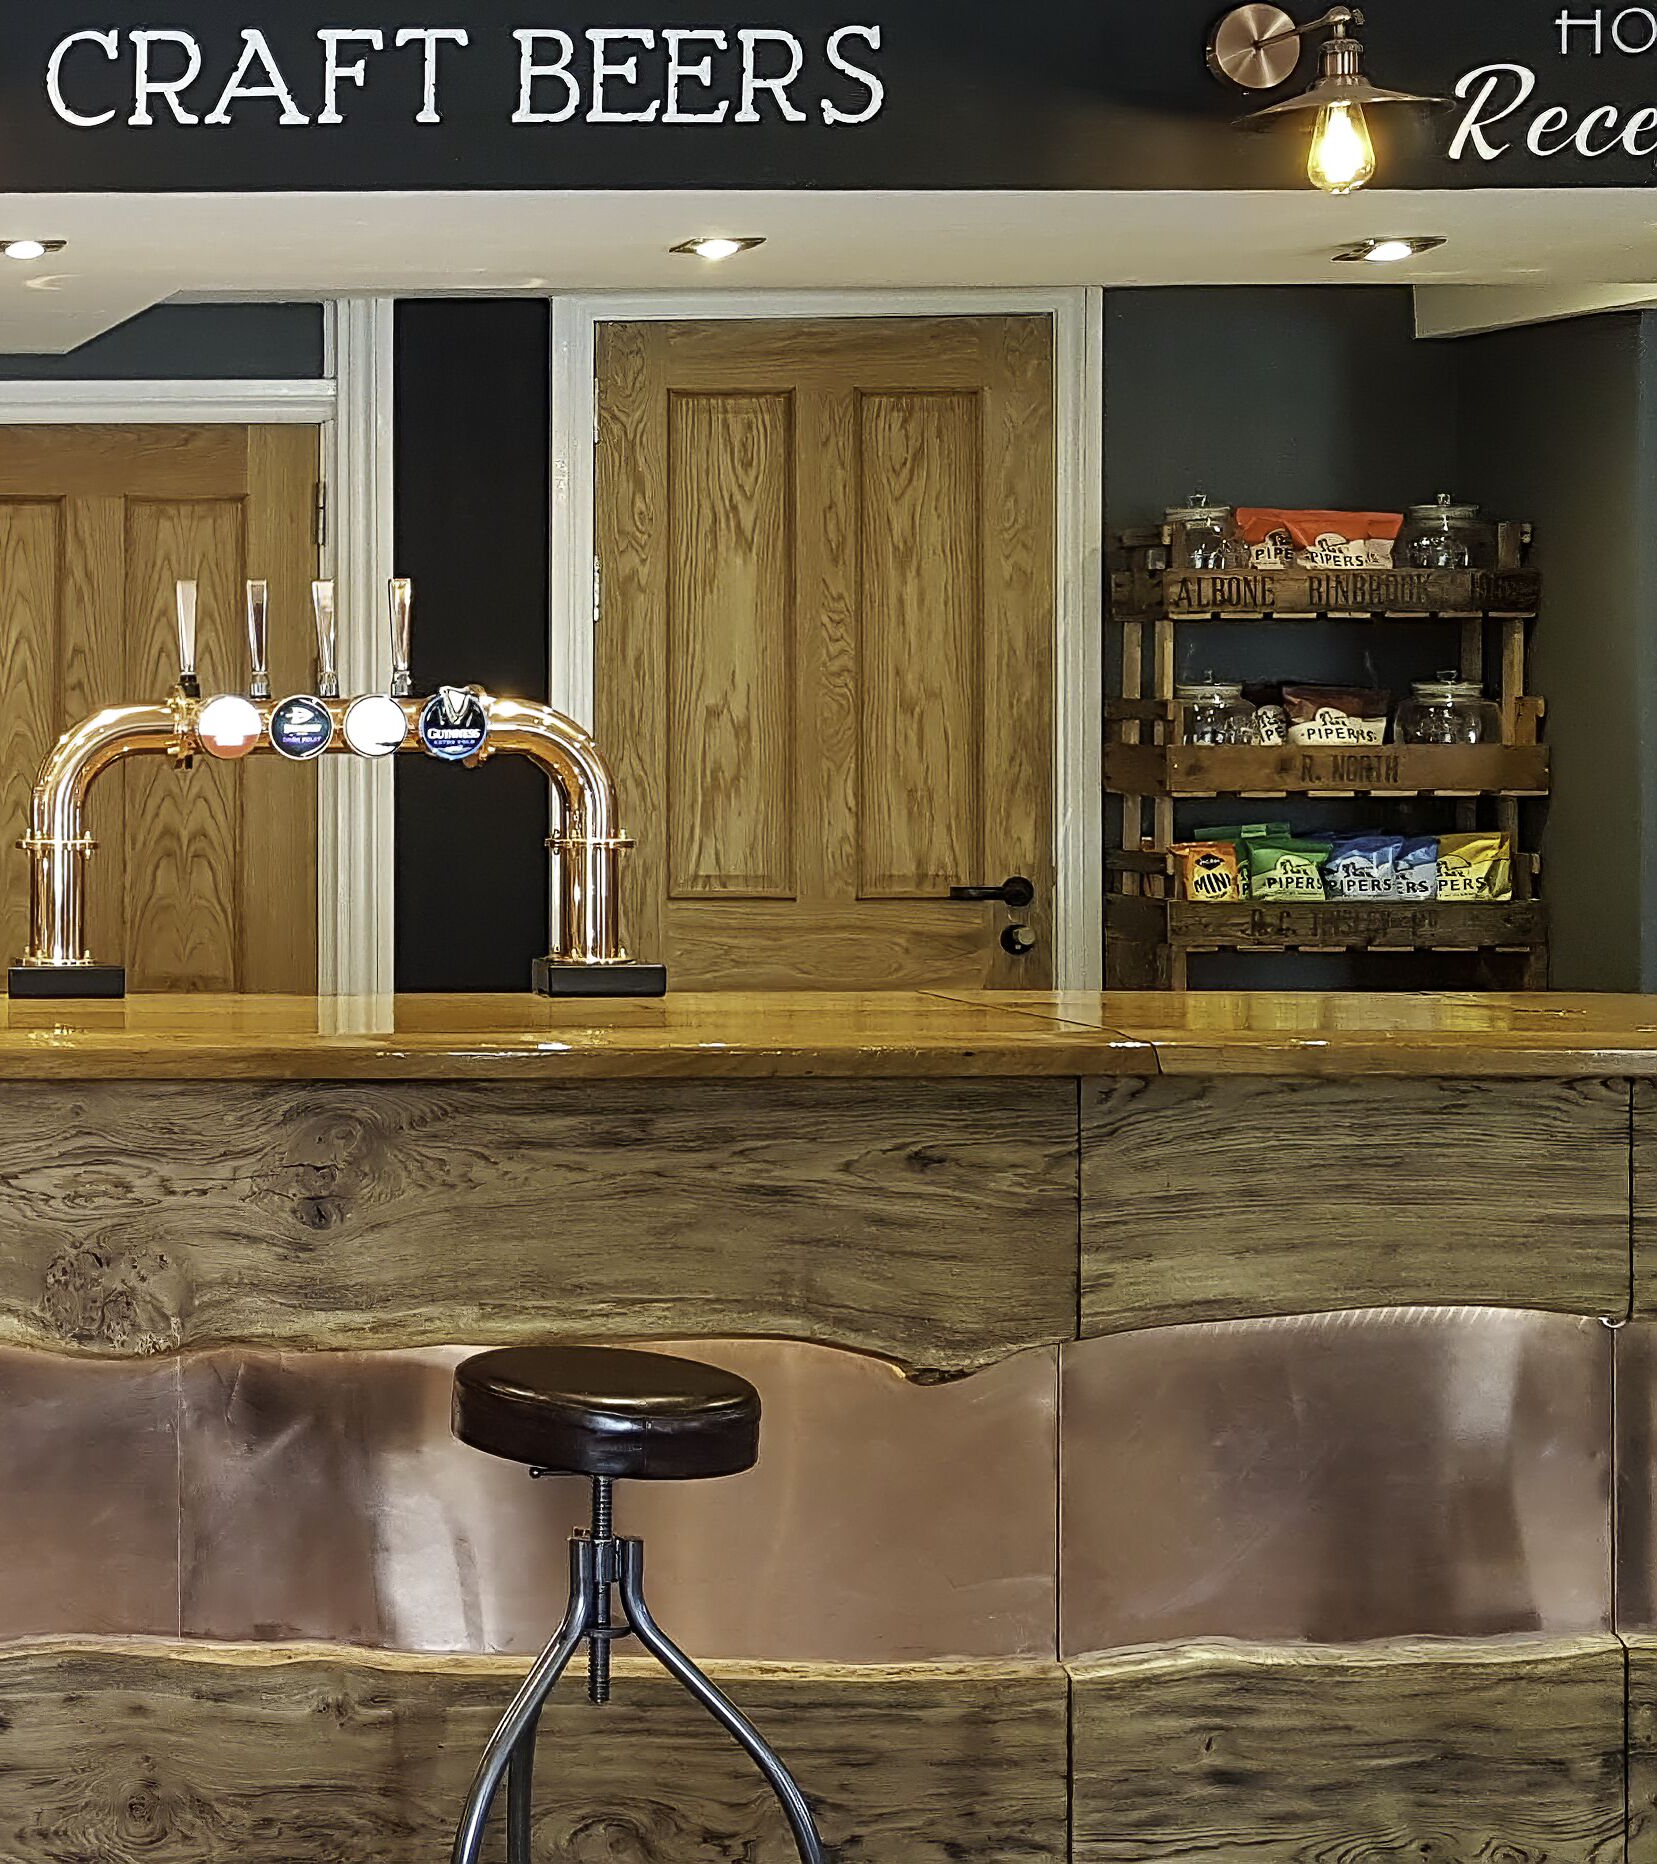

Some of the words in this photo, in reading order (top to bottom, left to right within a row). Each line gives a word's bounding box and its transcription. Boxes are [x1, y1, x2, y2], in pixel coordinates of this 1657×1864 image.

[46, 28, 471, 127] CRAFT
[511, 25, 885, 127] BEERS
[1255, 547, 1294, 562] PIPE
[1310, 551, 1364, 567] PIPERS
[1194, 872, 1231, 894] MINI
[1438, 877, 1487, 893] PERS
